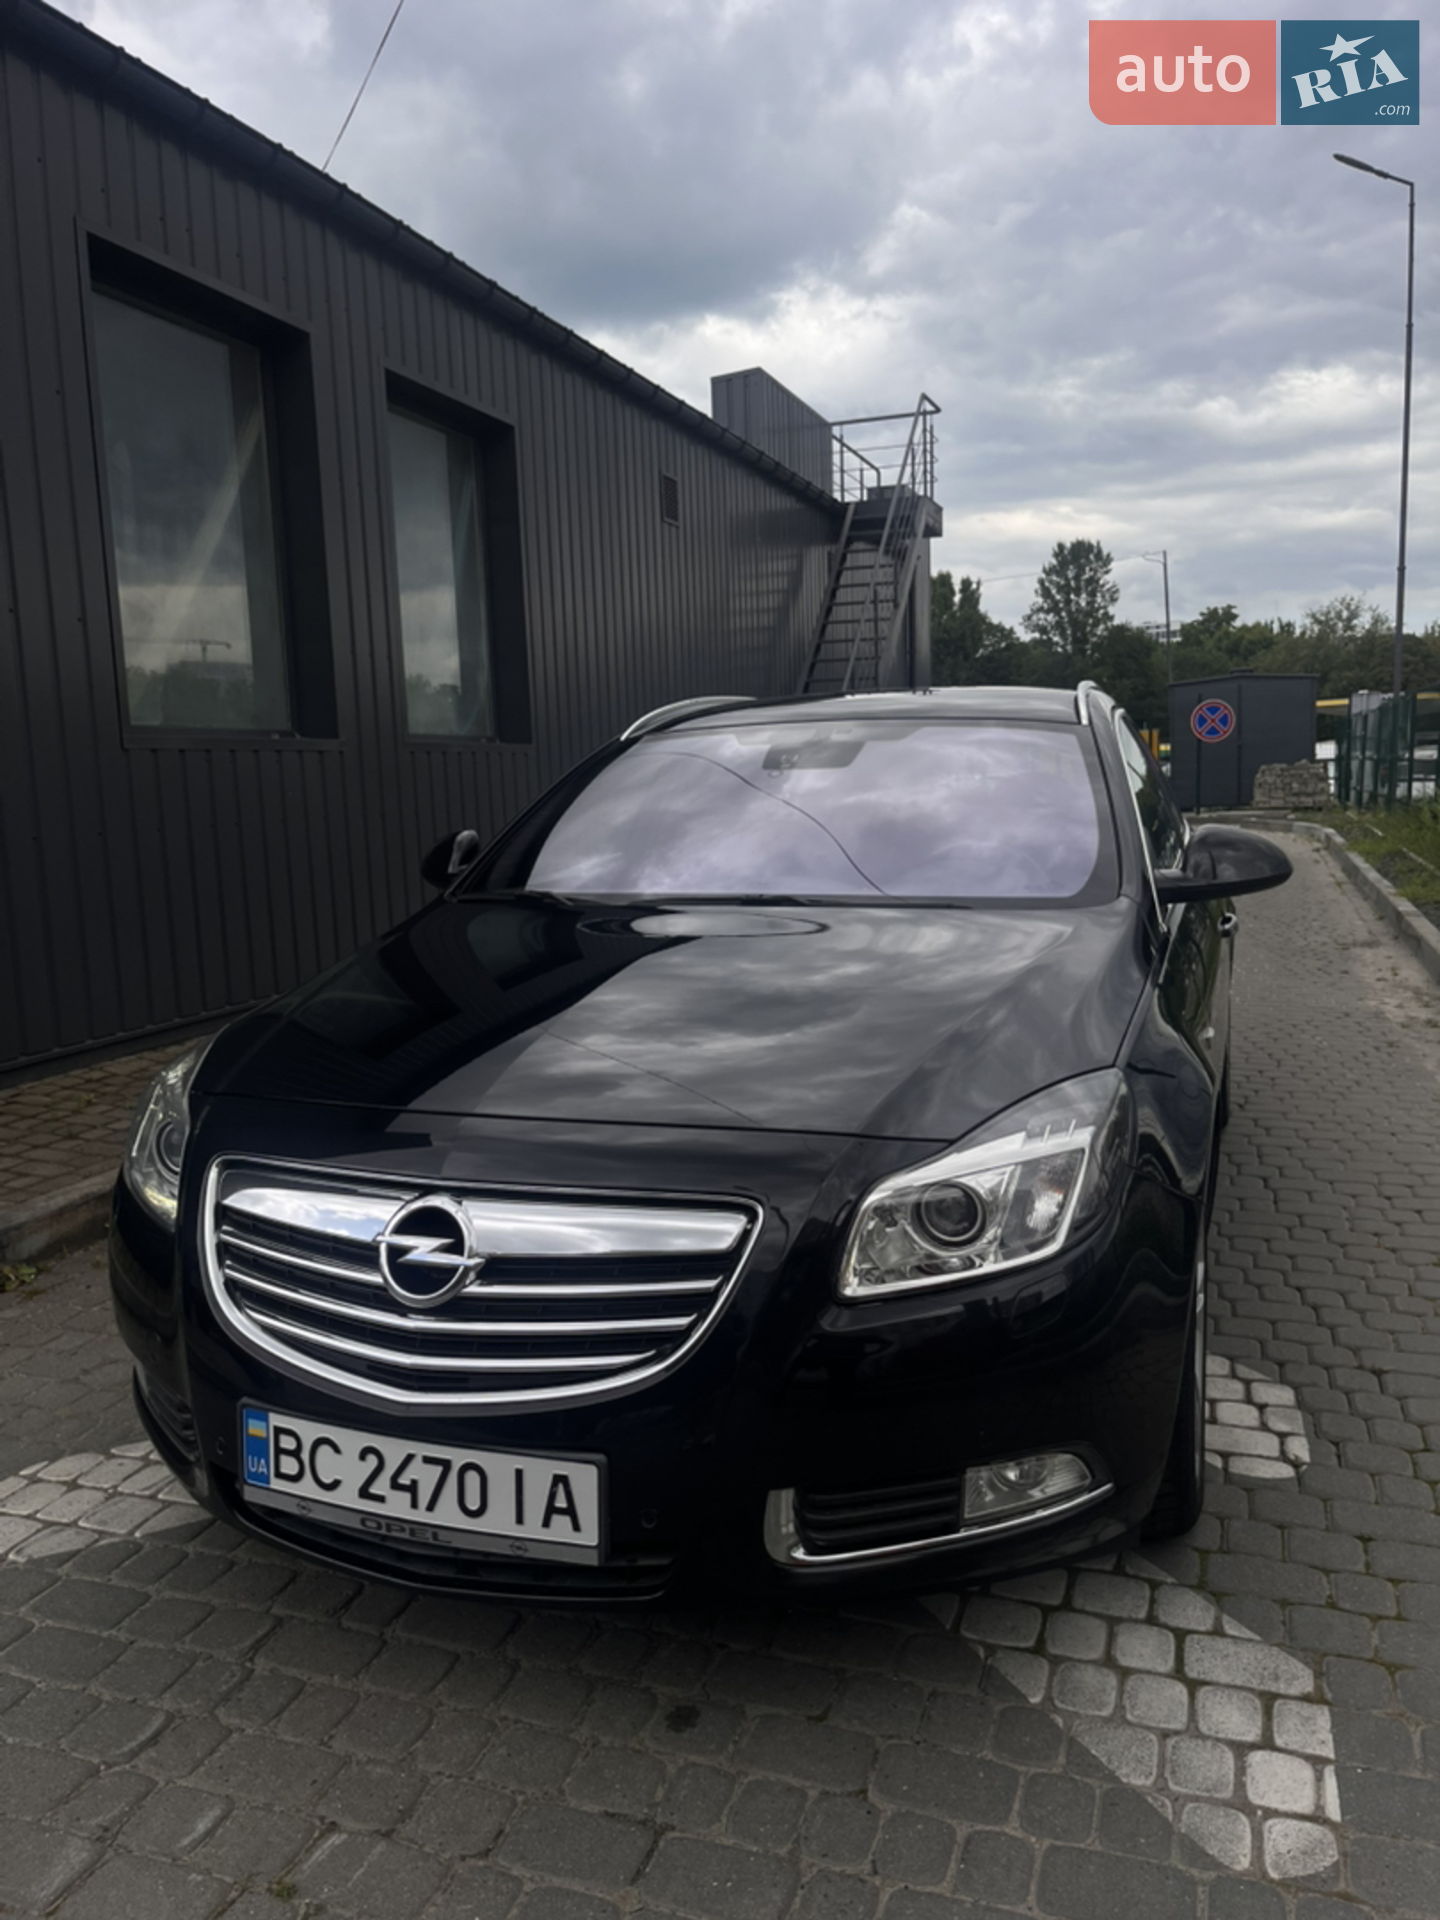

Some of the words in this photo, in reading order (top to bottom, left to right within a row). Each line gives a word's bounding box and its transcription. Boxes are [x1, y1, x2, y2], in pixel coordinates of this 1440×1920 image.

[247, 1455, 268, 1476] UA
[272, 1425, 342, 1492] BC
[357, 1445, 488, 1519] 2470
[514, 1465, 582, 1533] IA
[359, 1516, 453, 1545] OPEL
